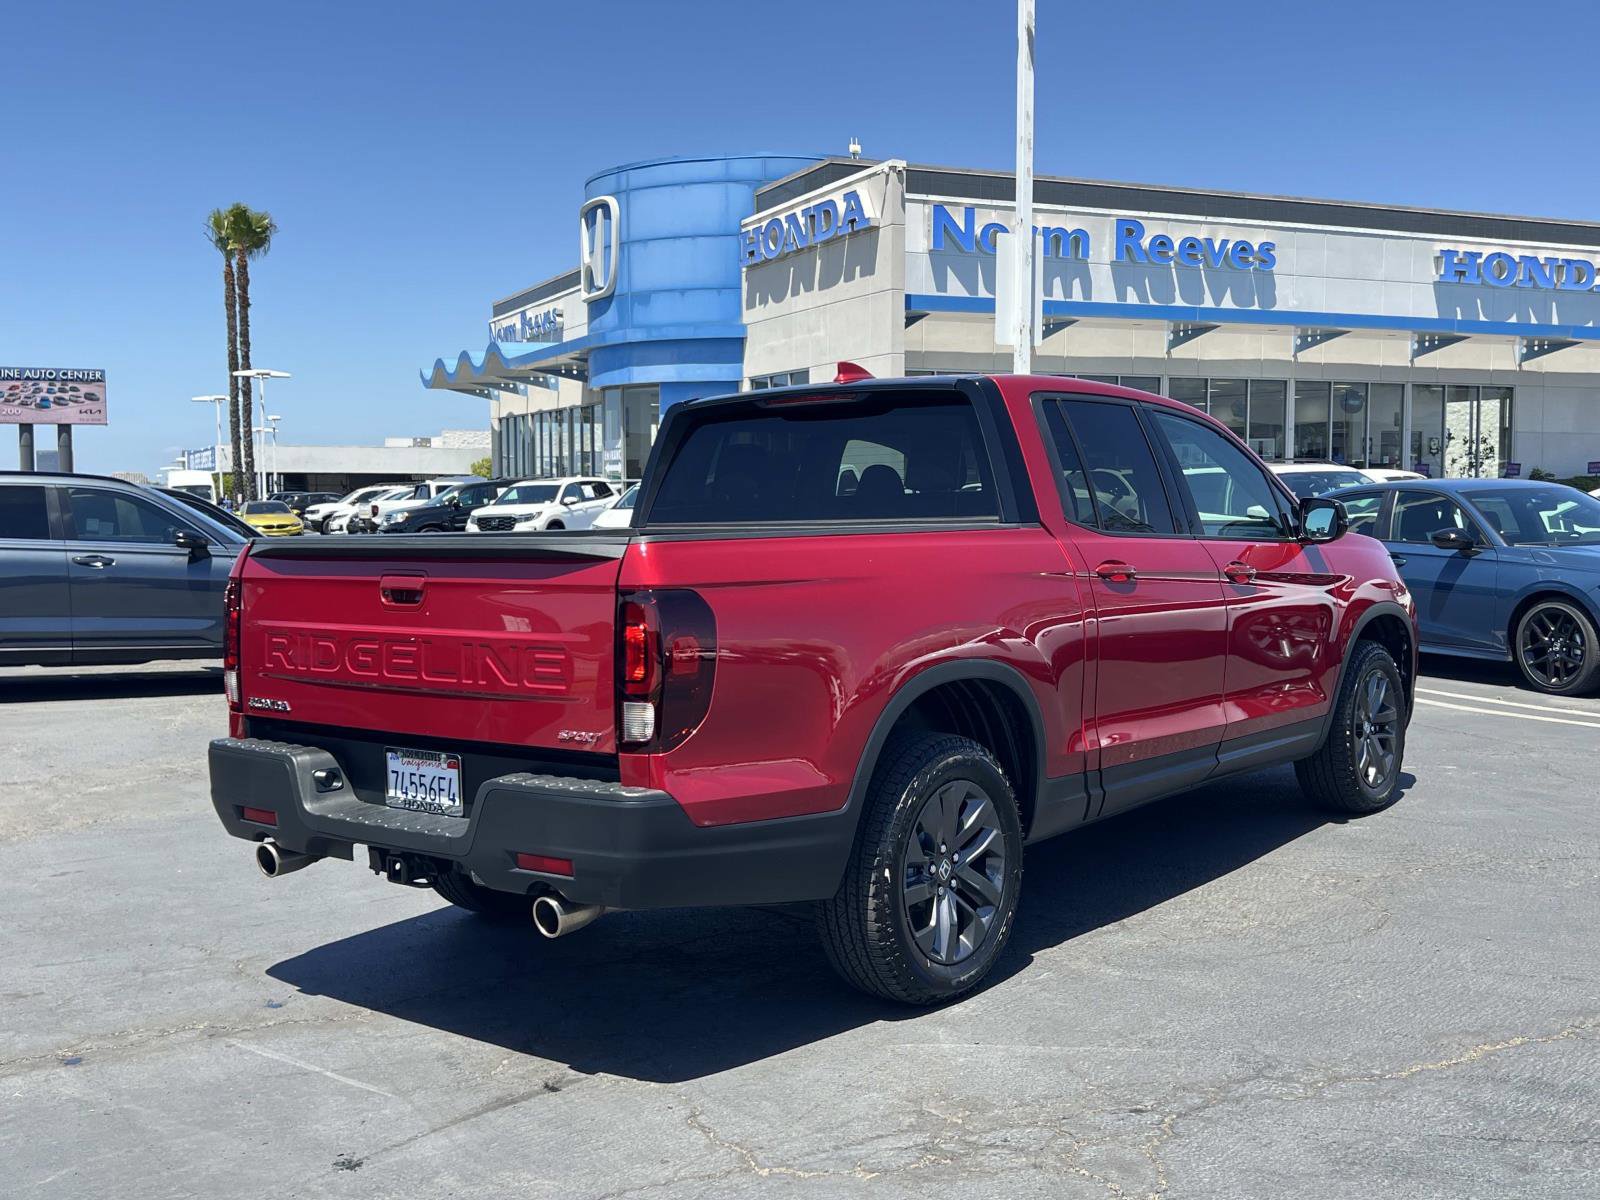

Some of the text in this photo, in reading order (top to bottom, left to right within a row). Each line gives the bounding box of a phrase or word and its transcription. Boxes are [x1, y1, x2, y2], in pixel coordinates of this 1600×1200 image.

[740, 190, 870, 268] HONDA
[932, 204, 1277, 270] Nom Reeves
[1440, 249, 1600, 292] HOND
[24, 369, 56, 379] AUTO
[60, 370, 102, 380] CENTER
[264, 632, 567, 690] RIDGELINE
[557, 730, 602, 745] SPORT
[391, 769, 457, 805] 74556F4
[403, 799, 446, 814] HONDA
